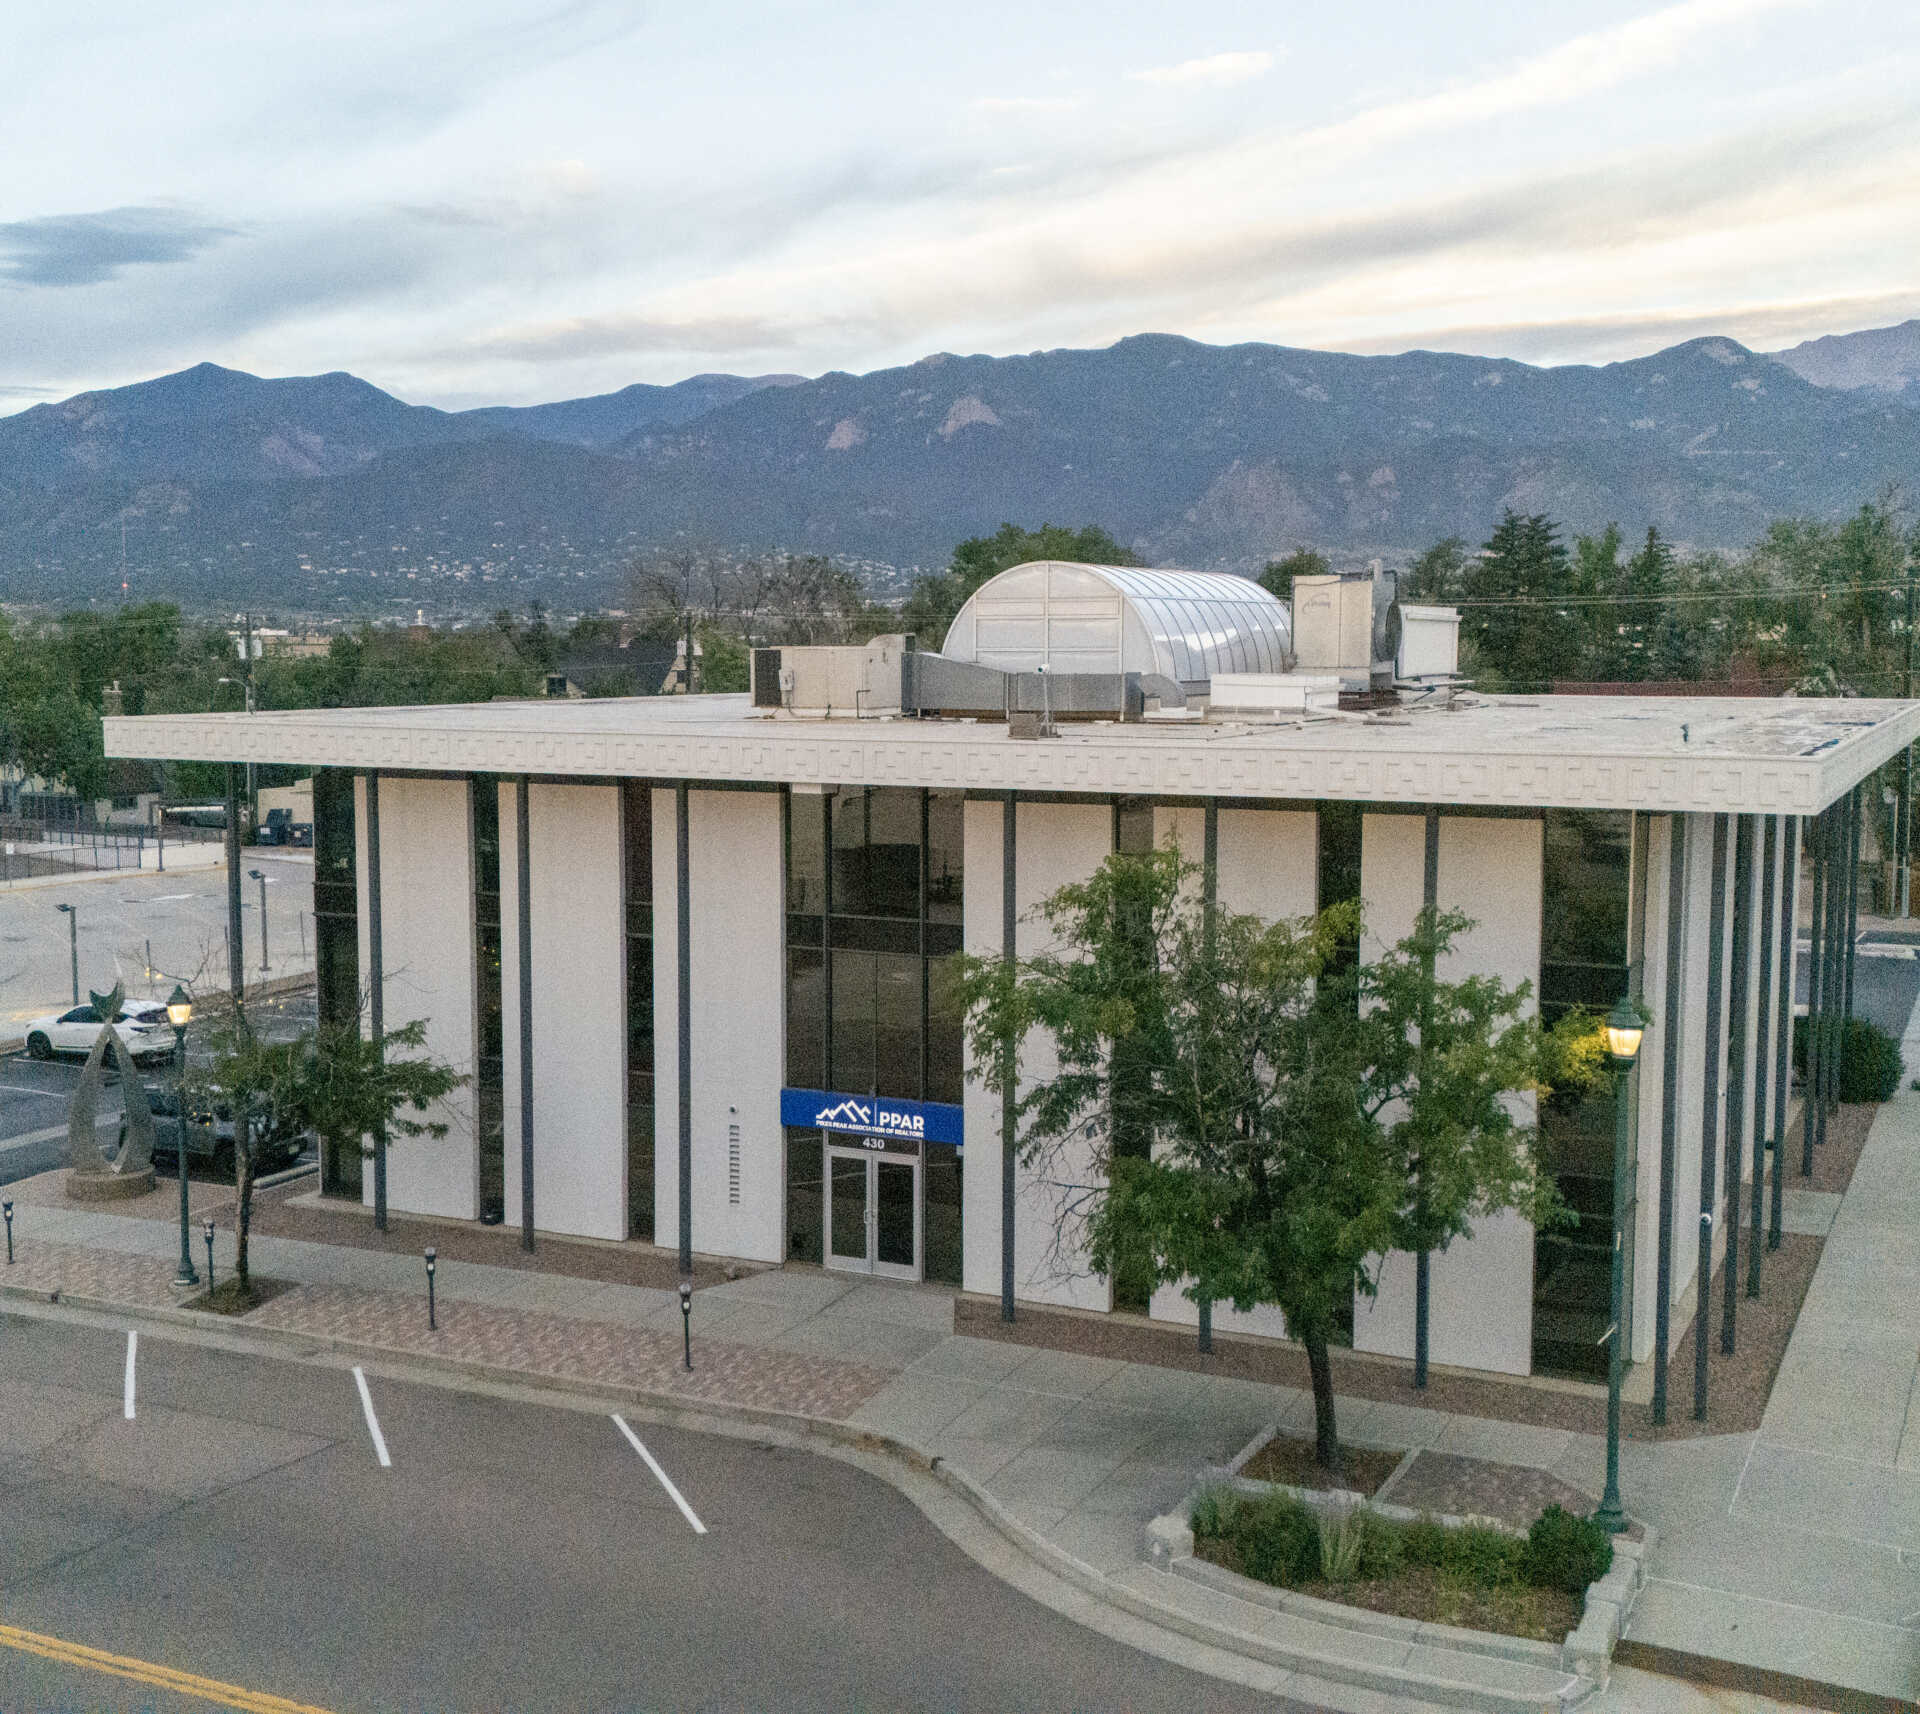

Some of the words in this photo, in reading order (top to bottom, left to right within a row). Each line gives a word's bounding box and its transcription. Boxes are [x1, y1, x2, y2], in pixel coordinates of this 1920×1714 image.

[879, 1112, 924, 1130] PPAR
[848, 1124, 885, 1133] ASSOCIATION
[895, 1129, 924, 1138] REALTORS
[862, 1138, 885, 1149] 430
